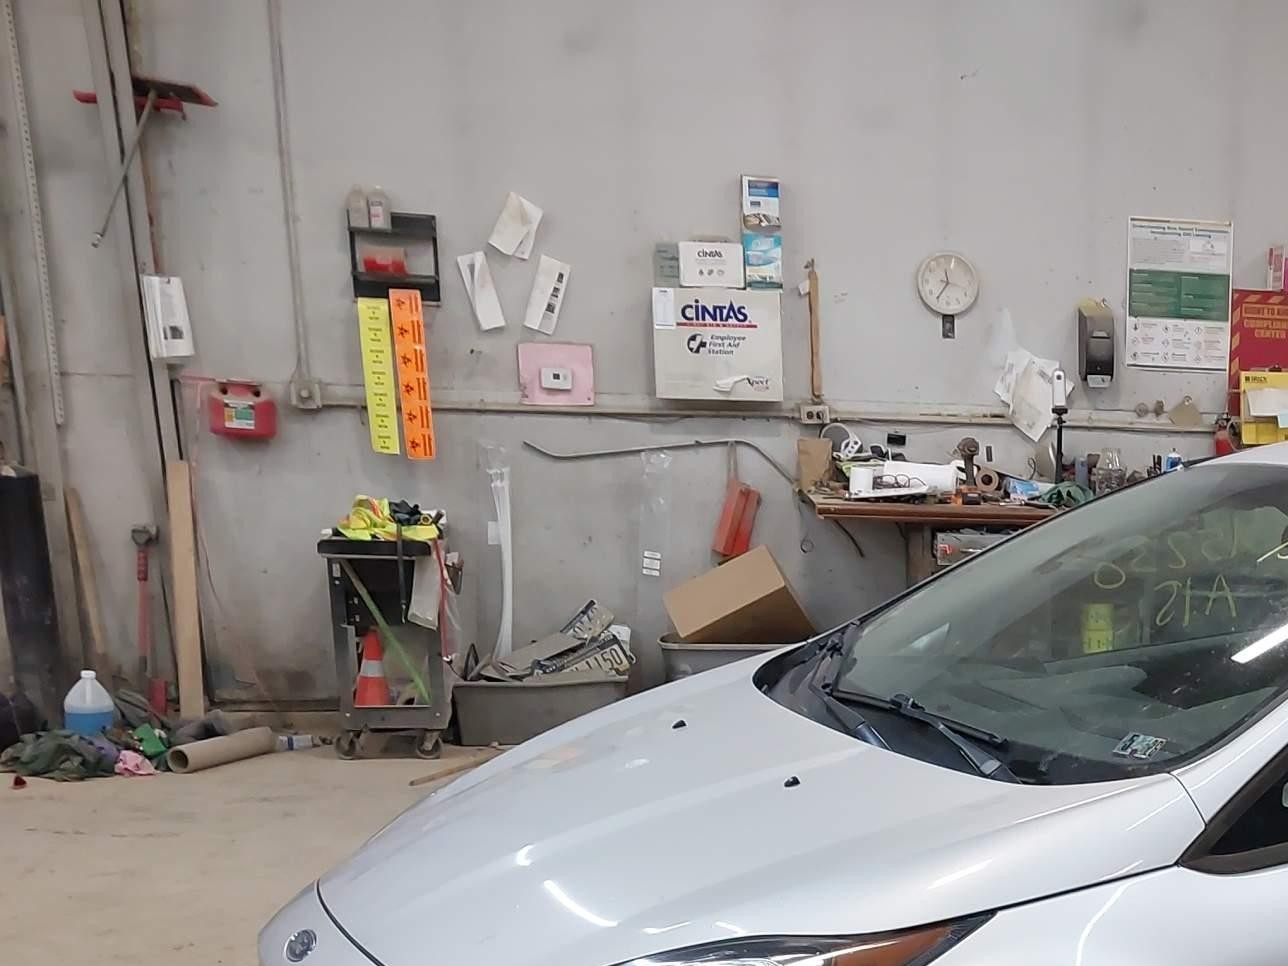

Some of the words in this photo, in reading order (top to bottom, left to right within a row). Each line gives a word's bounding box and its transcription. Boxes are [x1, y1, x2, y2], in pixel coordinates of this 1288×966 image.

[681, 298, 748, 322] CINTAS
[710, 334, 747, 343] Employee
[708, 341, 725, 349] First
[726, 341, 741, 349] Aid
[707, 348, 734, 356] Station
